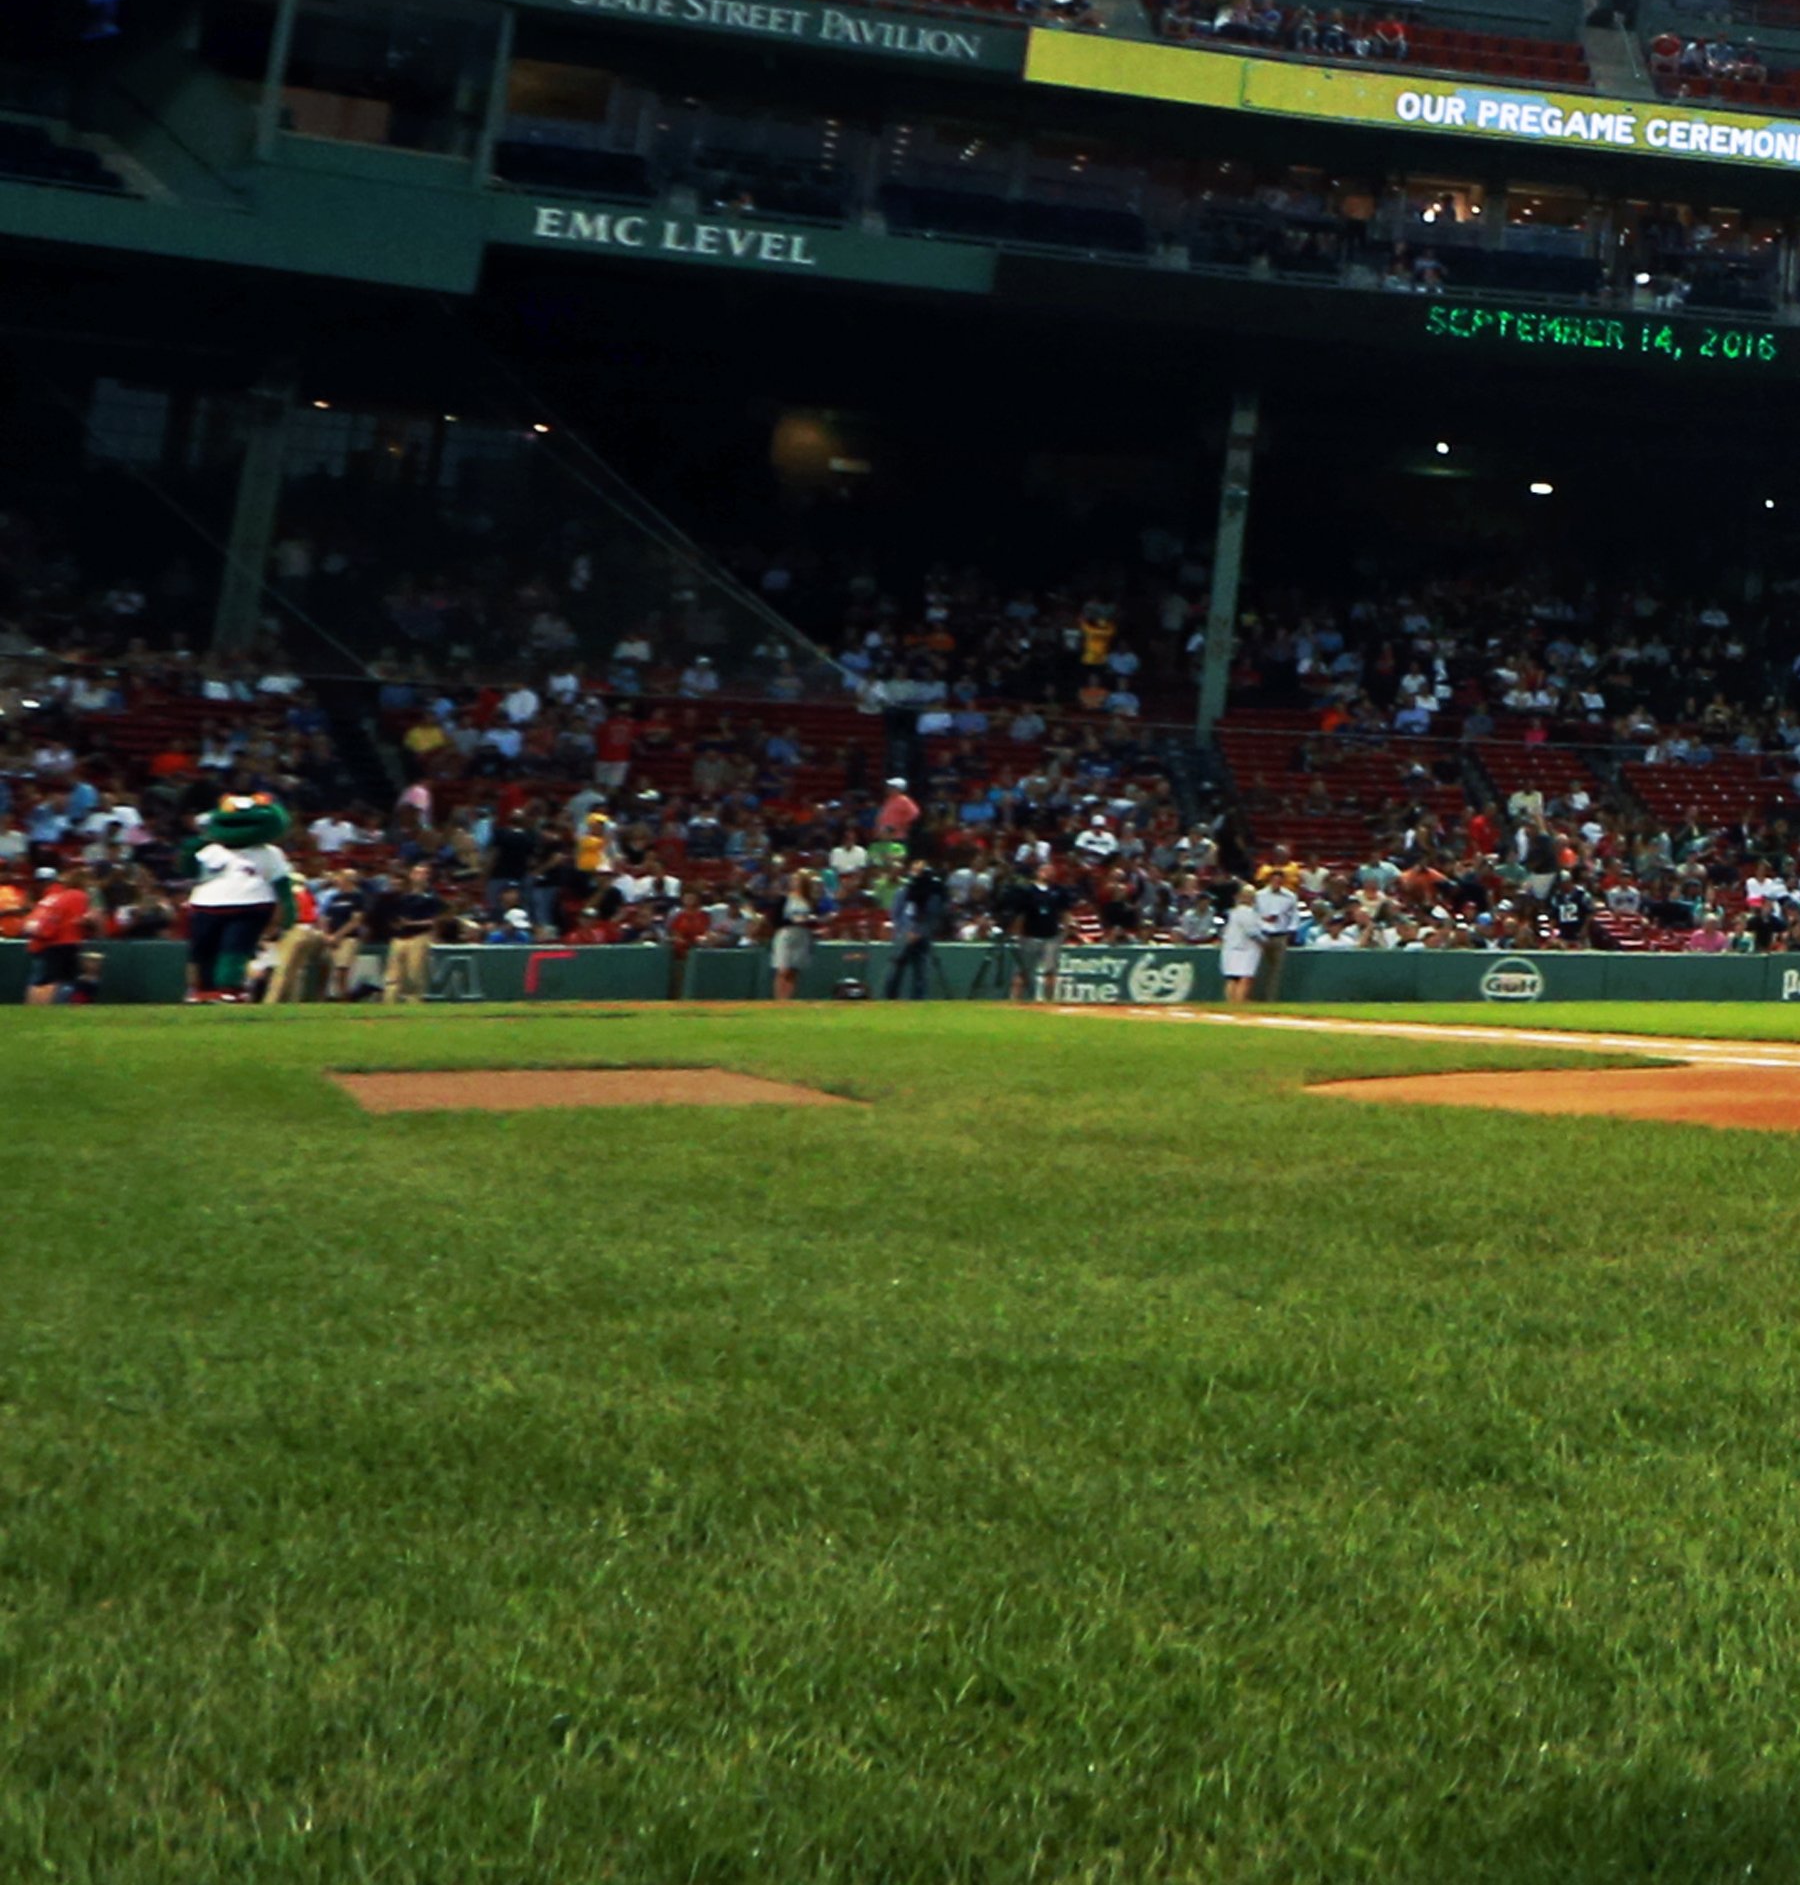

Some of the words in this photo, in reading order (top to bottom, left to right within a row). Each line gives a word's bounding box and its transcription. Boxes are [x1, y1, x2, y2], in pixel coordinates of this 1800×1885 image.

[819, 8, 981, 59] PAVILION
[1396, 92, 1466, 124] OUR
[1477, 101, 1637, 144] PREGAME
[534, 206, 648, 246] EMC
[660, 221, 815, 265] LEVEL
[1426, 306, 1624, 350] SEPTEMBER
[1641, 323, 1681, 360] 14,
[1699, 328, 1776, 360] 2016
